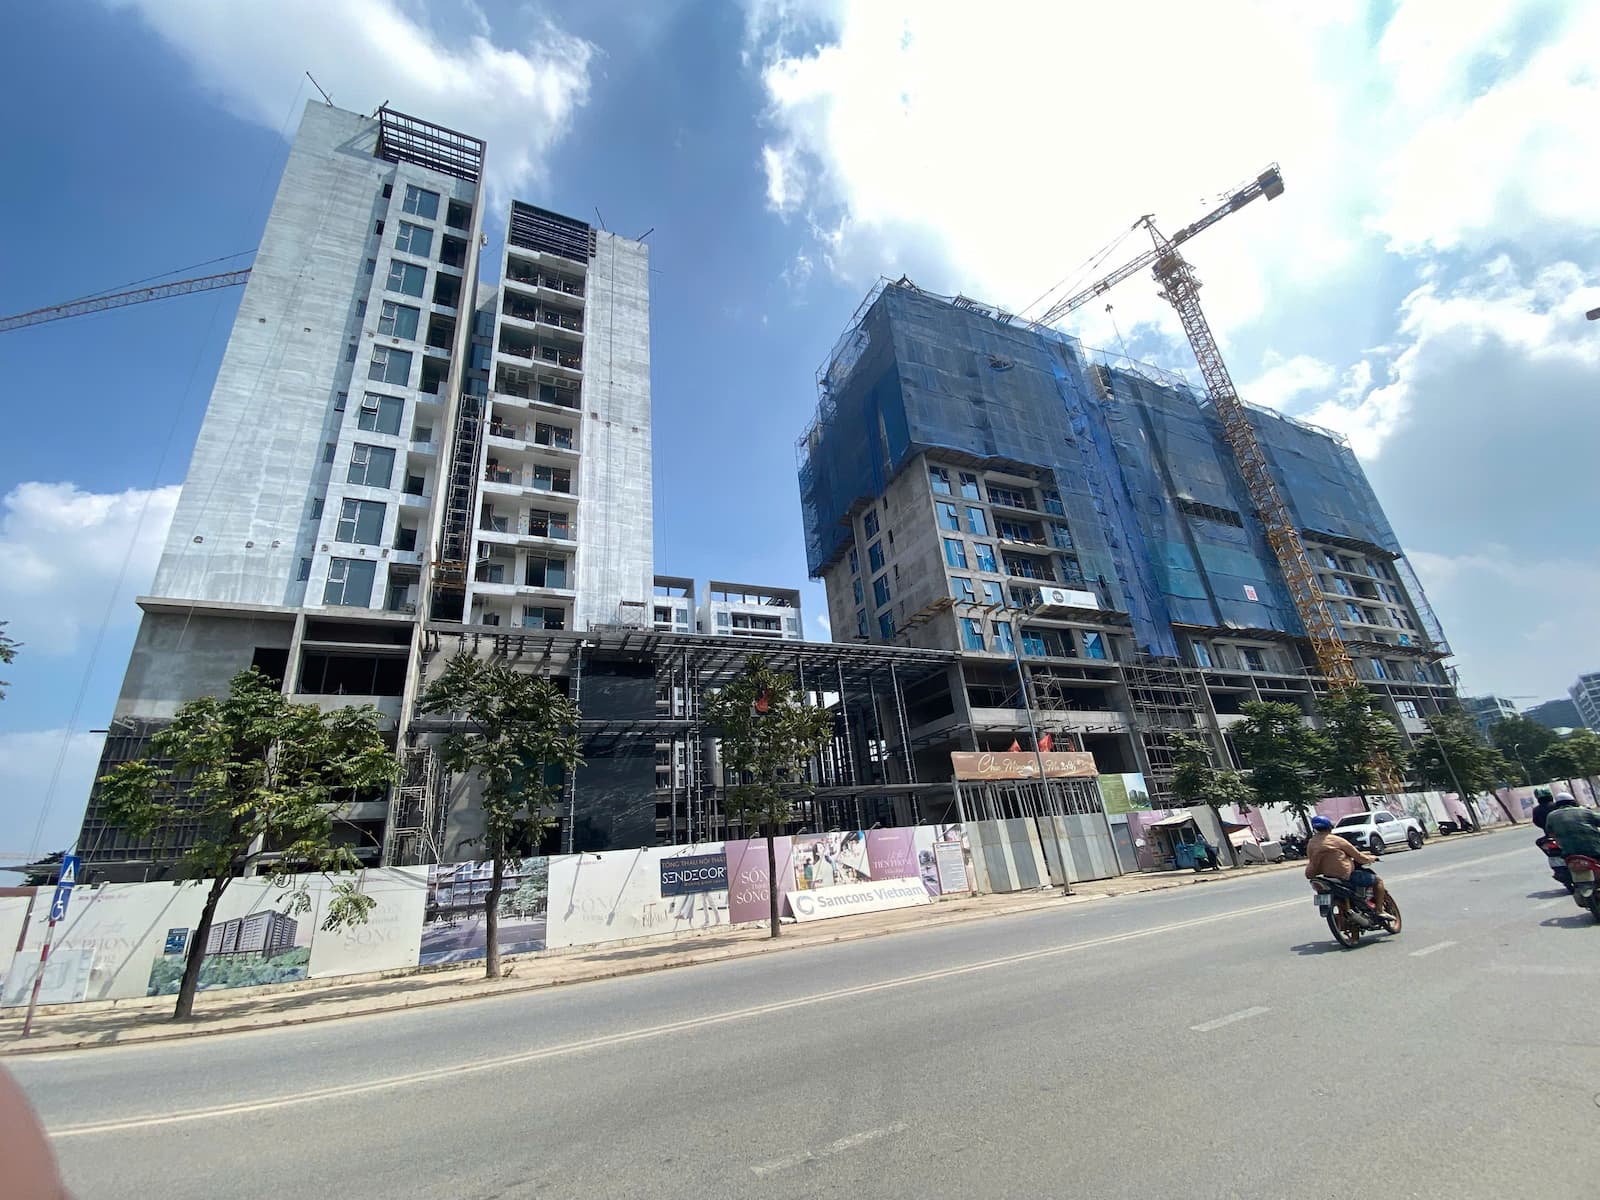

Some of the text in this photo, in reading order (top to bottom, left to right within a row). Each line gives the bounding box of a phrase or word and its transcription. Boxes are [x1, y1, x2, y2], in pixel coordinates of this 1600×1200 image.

[662, 866, 725, 884] SENDECOR
[817, 886, 925, 908] Samcons Vietnam
